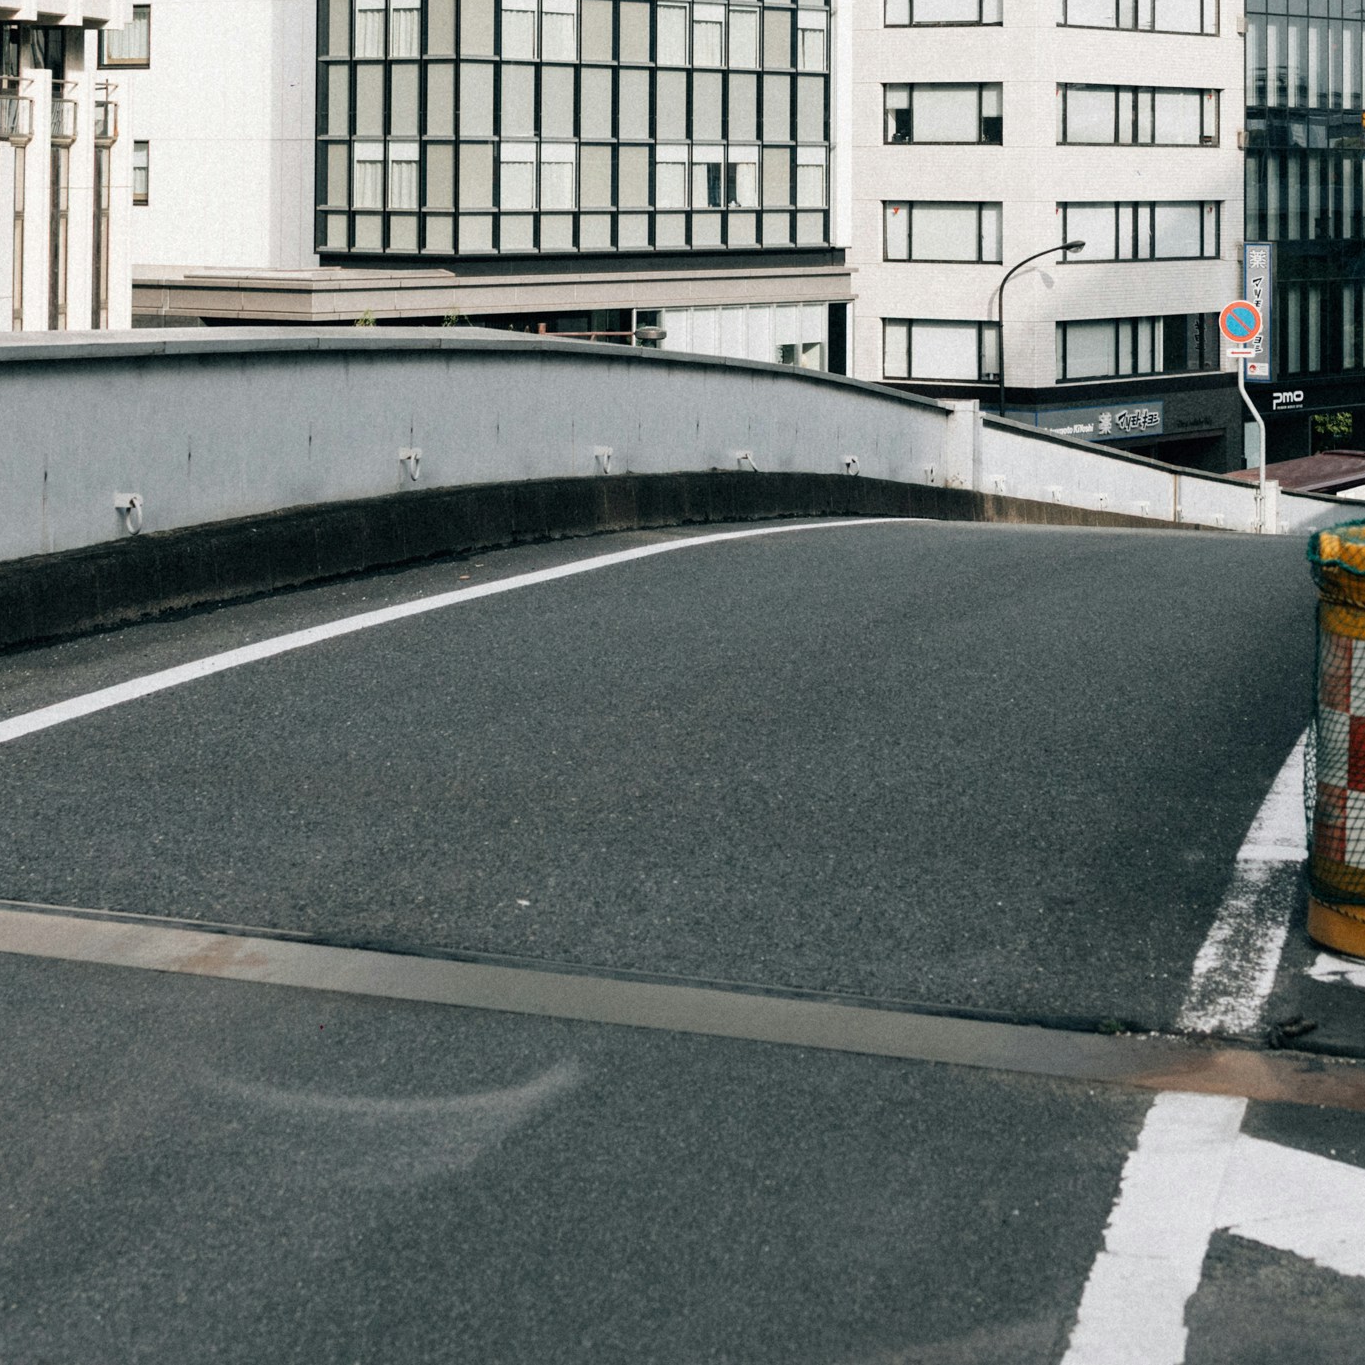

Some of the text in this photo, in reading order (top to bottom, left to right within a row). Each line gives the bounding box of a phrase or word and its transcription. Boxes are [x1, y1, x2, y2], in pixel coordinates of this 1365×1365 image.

[1249, 249, 1267, 269] 薬
[1251, 277, 1263, 353] マツモヨシ
[1098, 412, 1112, 435] 薬
[1117, 409, 1160, 431] マツモトキヨシ
